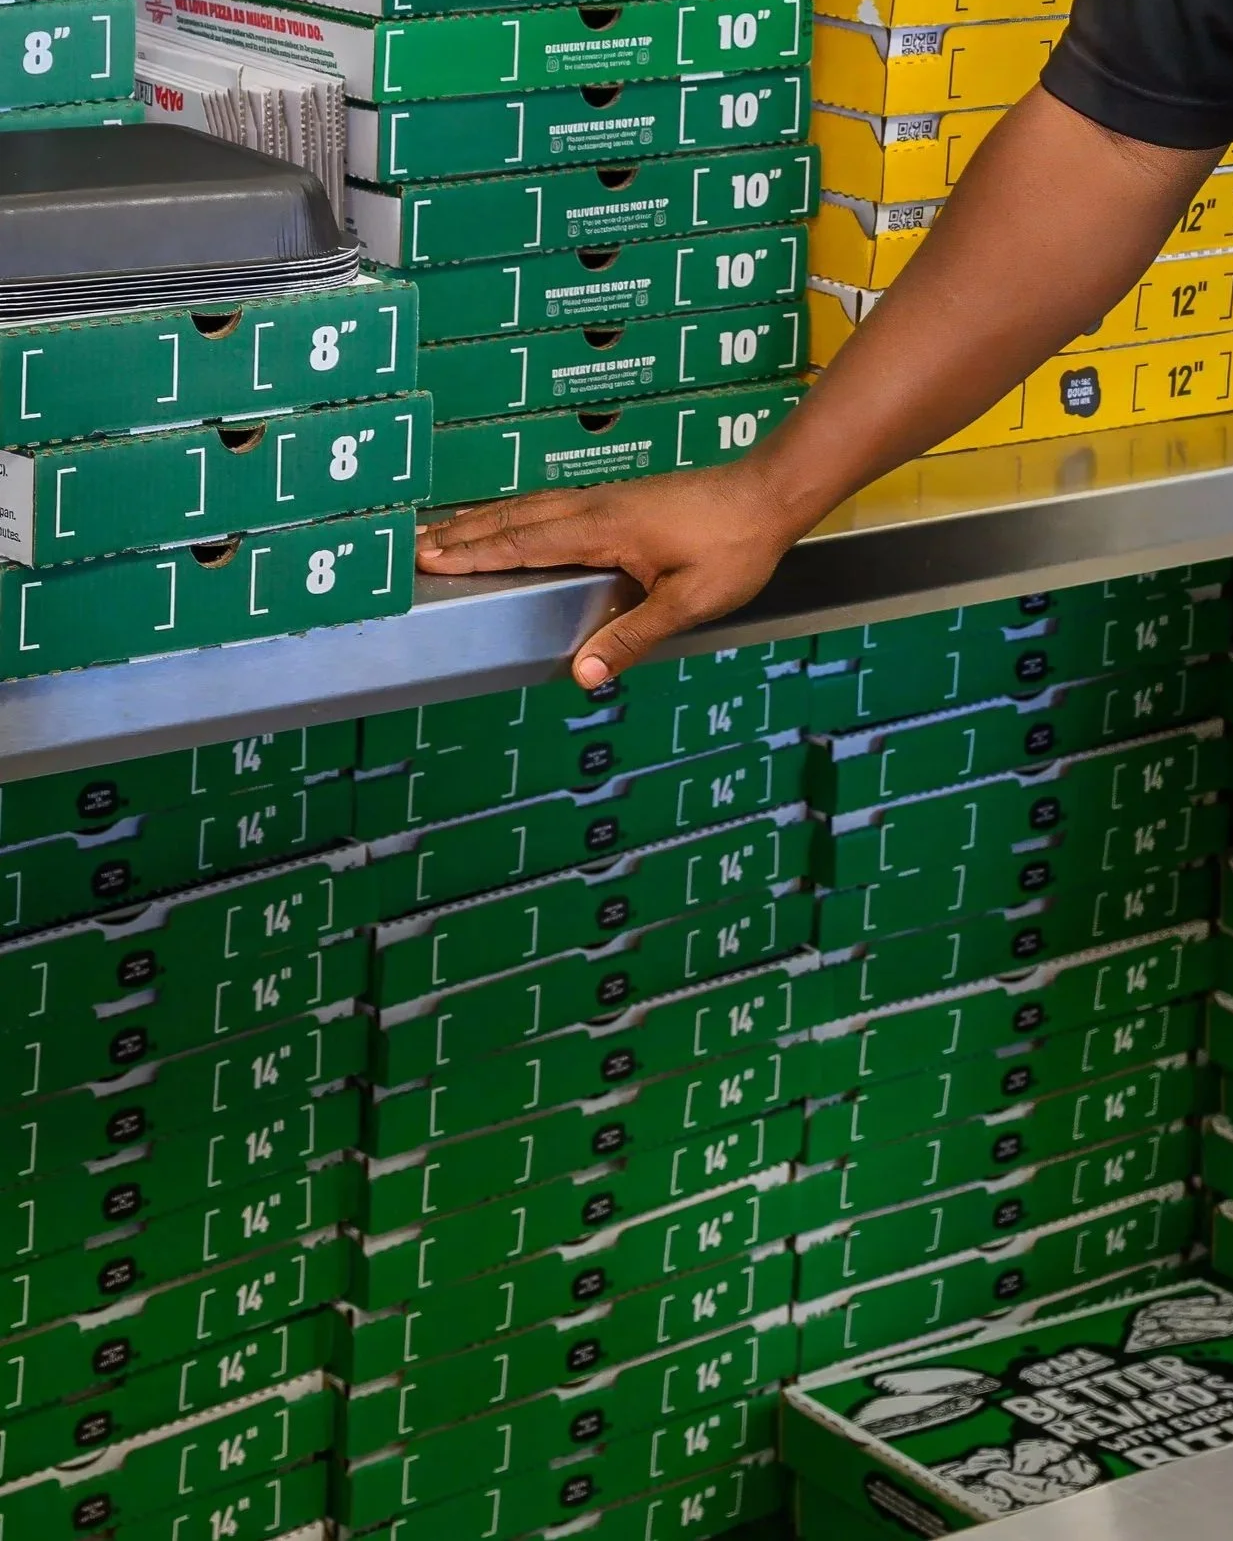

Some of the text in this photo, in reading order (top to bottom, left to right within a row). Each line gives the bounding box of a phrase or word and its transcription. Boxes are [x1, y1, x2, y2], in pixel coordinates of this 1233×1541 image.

[718, 9, 771, 50] 10"
[22, 26, 71, 74] 8"
[155, 84, 183, 111] PAPA
[719, 89, 772, 129] 10"
[731, 168, 782, 209] 10"
[715, 249, 767, 290] 10"
[1171, 282, 1207, 318] 12"
[310, 320, 357, 371] 8"
[719, 325, 770, 366] 10"
[1167, 362, 1203, 398] 12"
[718, 409, 770, 450] 10"
[329, 429, 375, 481] 8"
[305, 543, 354, 595] 8"
[1135, 615, 1168, 651] 14"
[707, 696, 743, 735] 14"
[1133, 683, 1163, 717] 14"
[232, 733, 274, 775] 14"
[710, 768, 745, 807] 14"
[1142, 757, 1174, 792] 14"
[237, 806, 276, 849] 14"
[1134, 820, 1167, 854] 14"
[719, 845, 753, 885] 14"
[263, 893, 303, 937] 14"
[1123, 885, 1155, 919] 14"
[717, 917, 750, 957] 14"
[252, 968, 292, 1011] 14"
[1125, 958, 1158, 994] 14"
[728, 996, 764, 1036] 14"
[1113, 1018, 1145, 1055] 14"
[251, 1045, 291, 1090] 14"
[719, 1069, 754, 1108] 14"
[1104, 1085, 1136, 1122] 14"
[245, 1120, 284, 1165] 14"
[704, 1134, 738, 1174] 14"
[1103, 1151, 1135, 1186] 14"
[241, 1193, 281, 1238] 14"
[698, 1211, 733, 1252] 14"
[1105, 1220, 1137, 1255] 14"
[236, 1272, 276, 1315] 14"
[692, 1281, 728, 1322] 14"
[217, 1343, 257, 1388] 14"
[696, 1352, 732, 1392] 14"
[1001, 1355, 1209, 1425] BETTER
[218, 1426, 258, 1471] 14"
[684, 1416, 720, 1456] 14"
[1098, 1423, 1176, 1451] WITH
[209, 1497, 250, 1541] 14"
[680, 1486, 716, 1526] 14"
